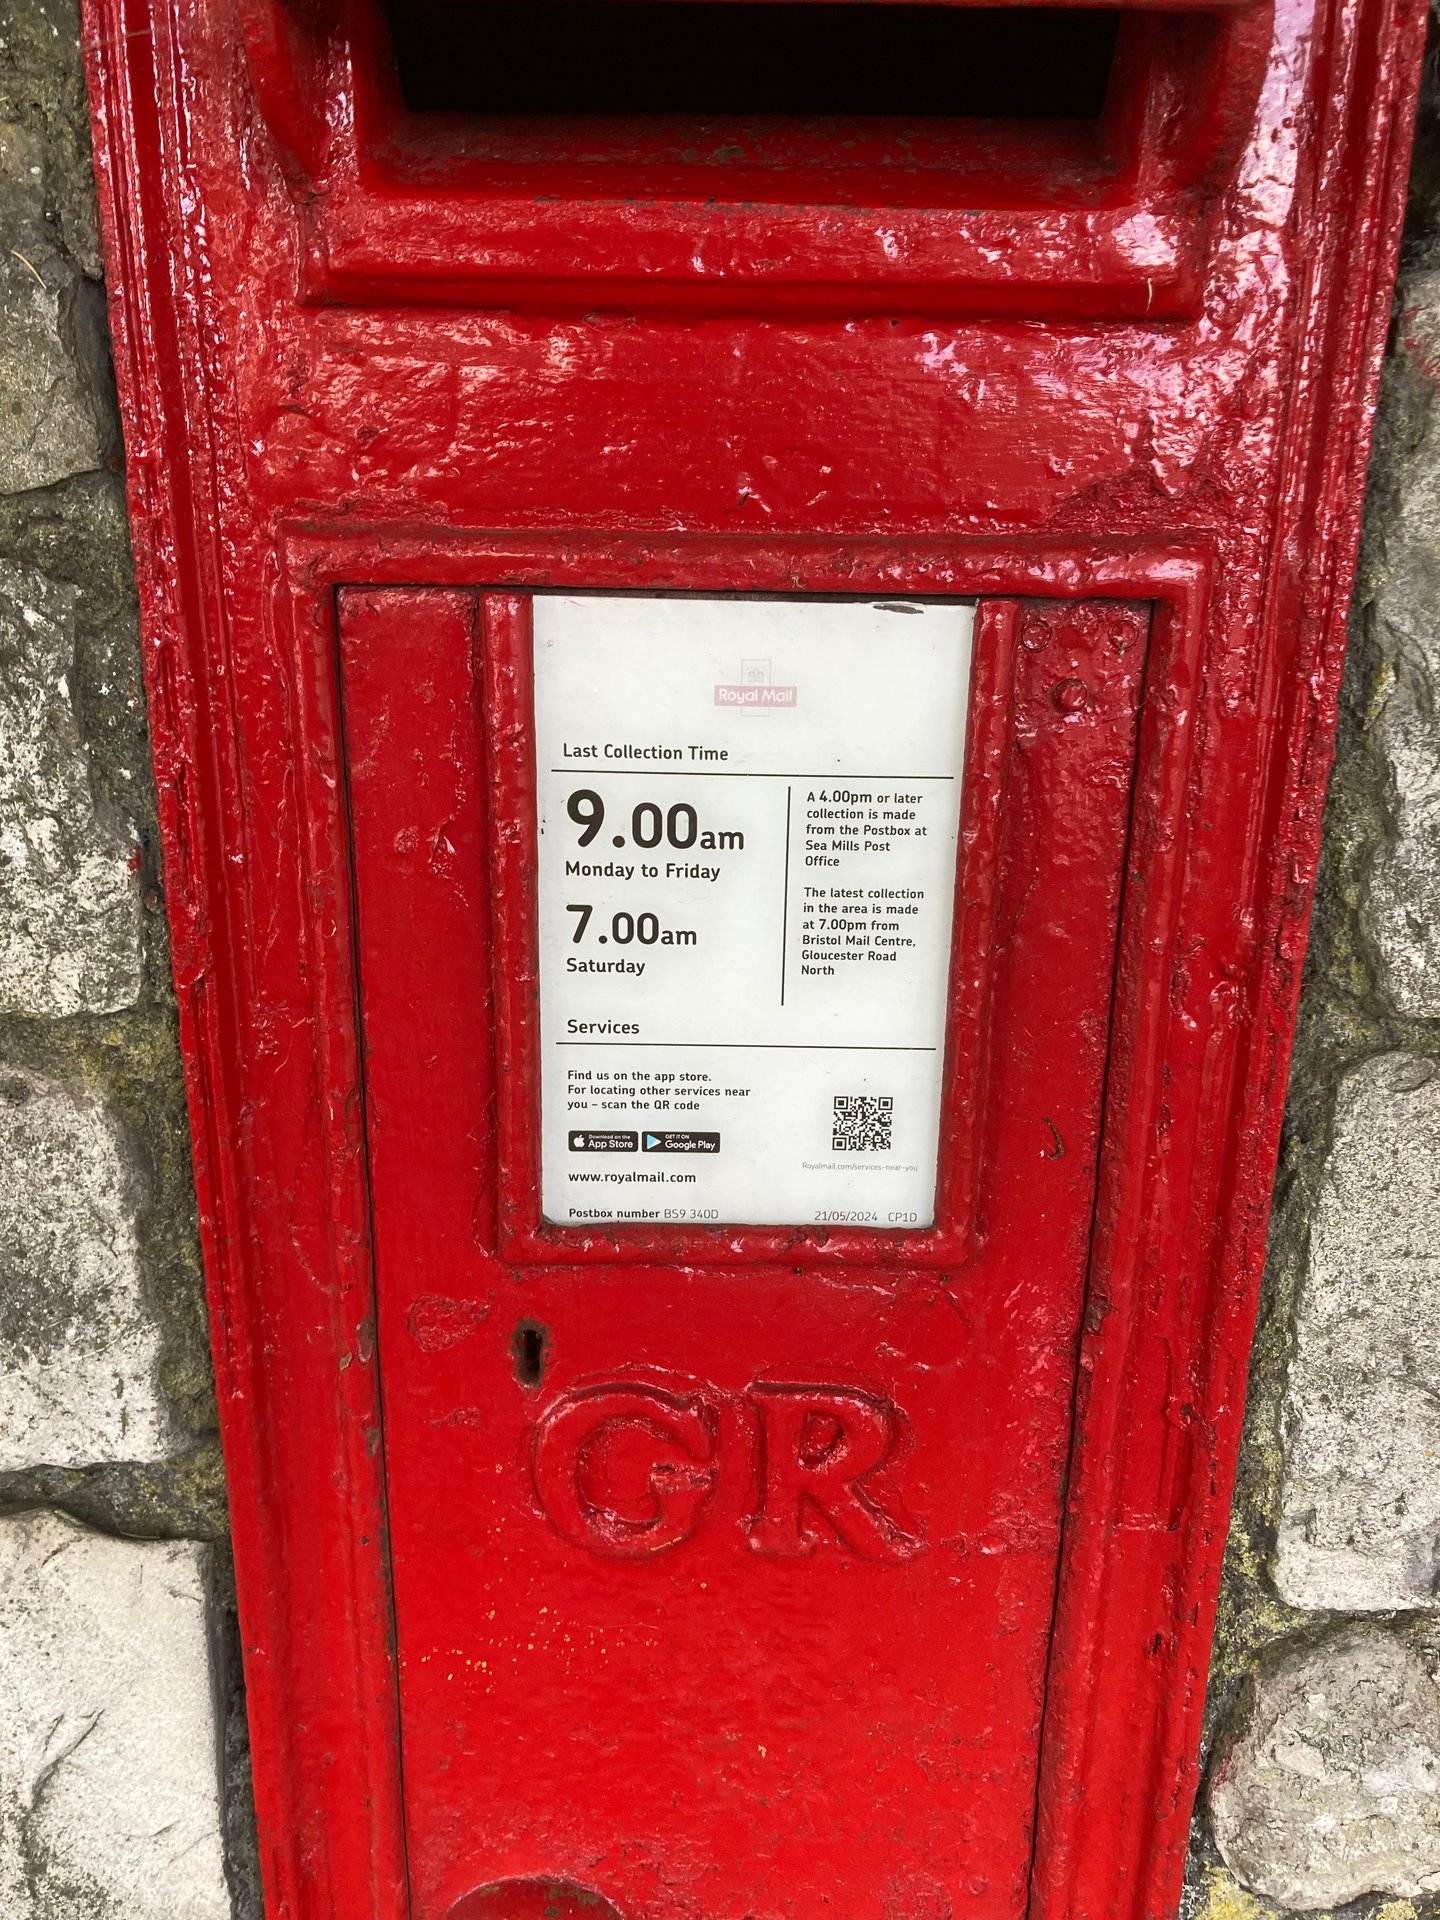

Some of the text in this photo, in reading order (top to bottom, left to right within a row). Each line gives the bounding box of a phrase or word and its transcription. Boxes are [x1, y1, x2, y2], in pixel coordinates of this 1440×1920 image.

[720, 688, 792, 704] Royal Mail
[564, 743, 728, 760] Last Collection Time
[807, 792, 815, 802] A
[819, 790, 871, 805] 4.00pm
[895, 793, 922, 803] later
[567, 789, 744, 850] 9.00am
[807, 809, 915, 819] collection is made
[806, 824, 927, 836] from the Postbox at
[806, 840, 890, 851] Sea Mills Post
[806, 856, 839, 866] Office
[566, 861, 720, 882] Monday to Friday
[804, 887, 923, 898] The latest collection
[804, 903, 813, 912] in
[819, 903, 837, 913] the
[873, 904, 881, 913] is
[887, 905, 918, 914] made
[566, 905, 696, 945] 7.00am
[803, 919, 899, 932] at 7.00pm from
[803, 935, 915, 946] Bristol Mail Centre,
[802, 950, 896, 961] Gloucester Road
[567, 958, 645, 976] Saturday
[802, 965, 834, 975] North
[568, 1019, 639, 1034] Services
[568, 1070, 591, 1079] Find
[632, 1072, 650, 1080] the
[655, 1074, 675, 1082] app
[680, 1073, 711, 1081] store.
[568, 1085, 586, 1094] For
[591, 1085, 635, 1096] locating
[640, 1086, 670, 1095] other
[675, 1086, 720, 1095] services
[568, 1102, 587, 1110] you
[632, 1100, 649, 1109] the
[655, 1100, 669, 1109] QR
[675, 1101, 699, 1109] code
[588, 1140, 633, 1149] App Store
[665, 1140, 715, 1150] Google Play
[802, 1162, 918, 1172] Royalmail.com/services-near-you
[569, 1172, 695, 1184] www.royalmail.com
[570, 1209, 718, 1219] Postbox number BS9 340D
[814, 1211, 917, 1222] 21/05/2024 CP1D
